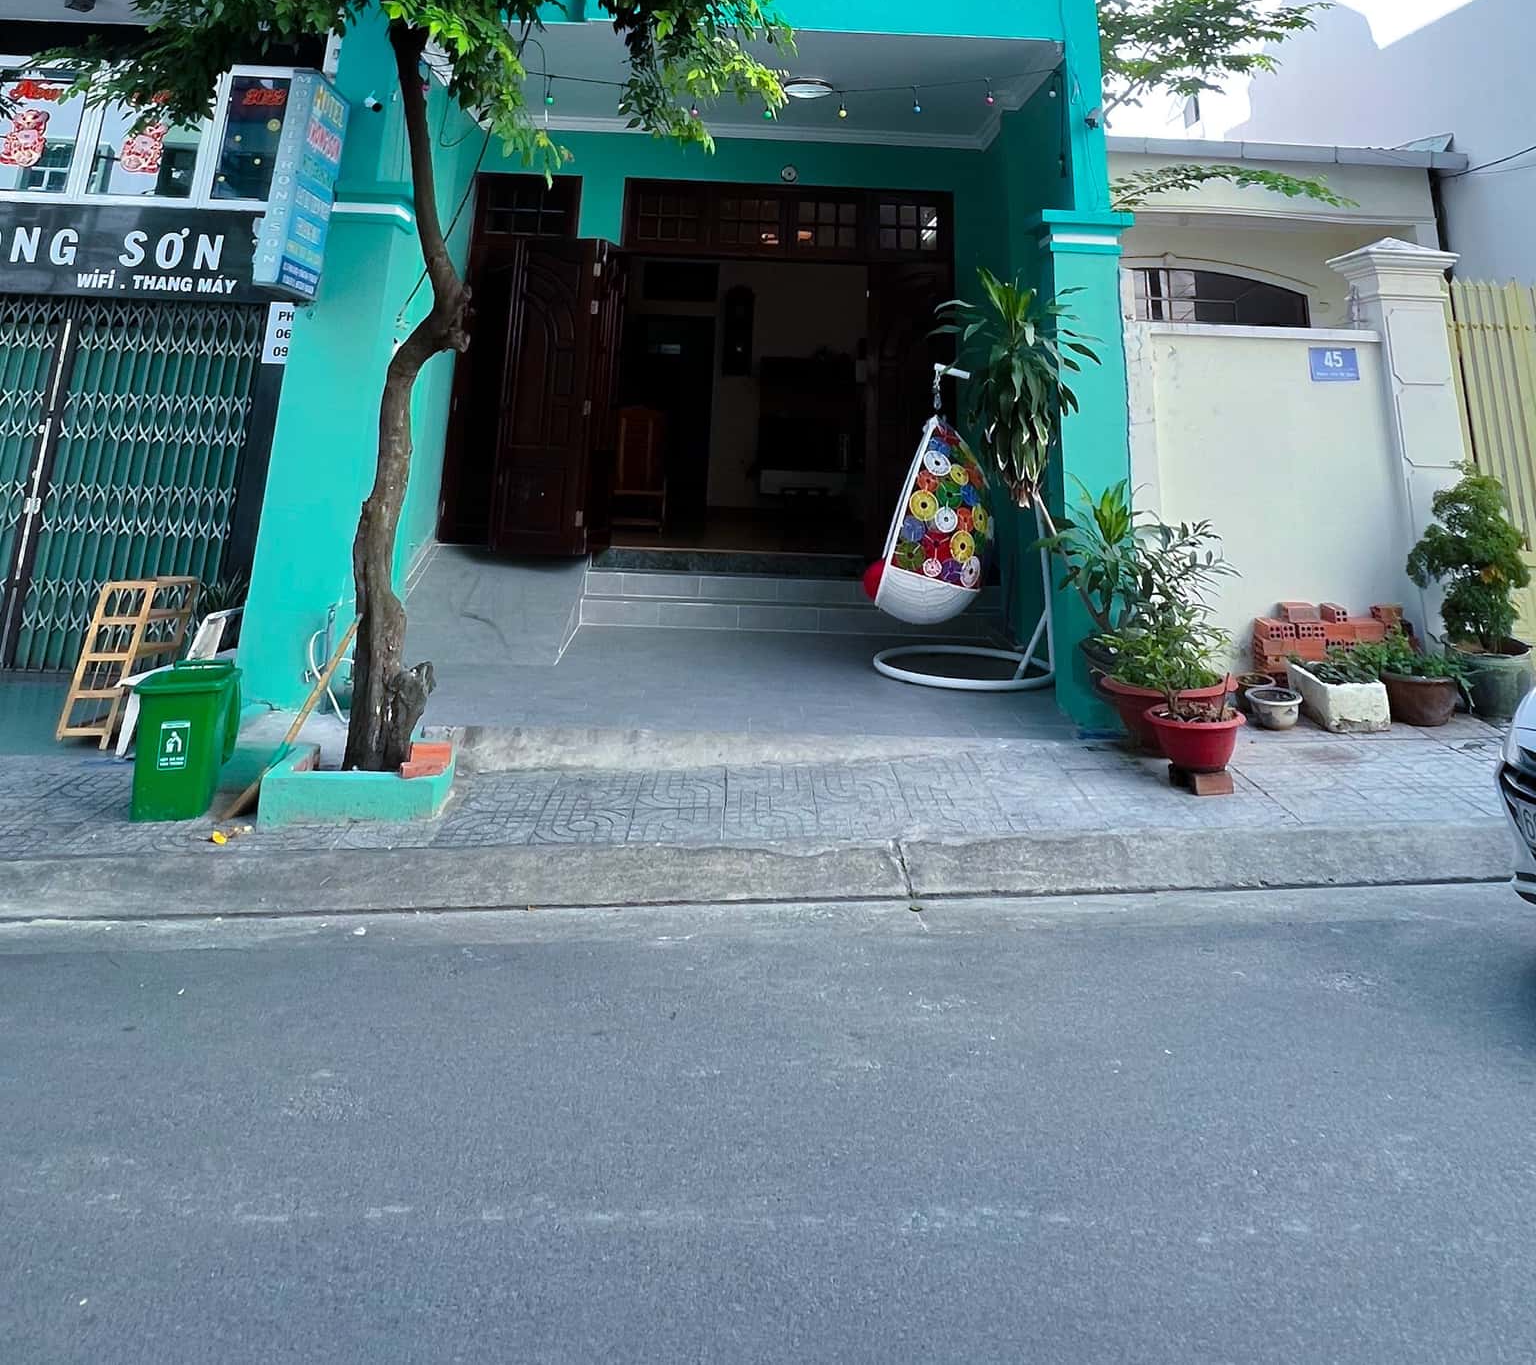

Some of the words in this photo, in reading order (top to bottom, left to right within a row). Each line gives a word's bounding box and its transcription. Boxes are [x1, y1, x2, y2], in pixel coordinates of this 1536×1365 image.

[0, 227, 79, 266] NG
[118, 227, 225, 271] SƠN
[133, 274, 193, 292] THANG
[197, 274, 238, 294] MÁY
[1324, 350, 1344, 368] 45
